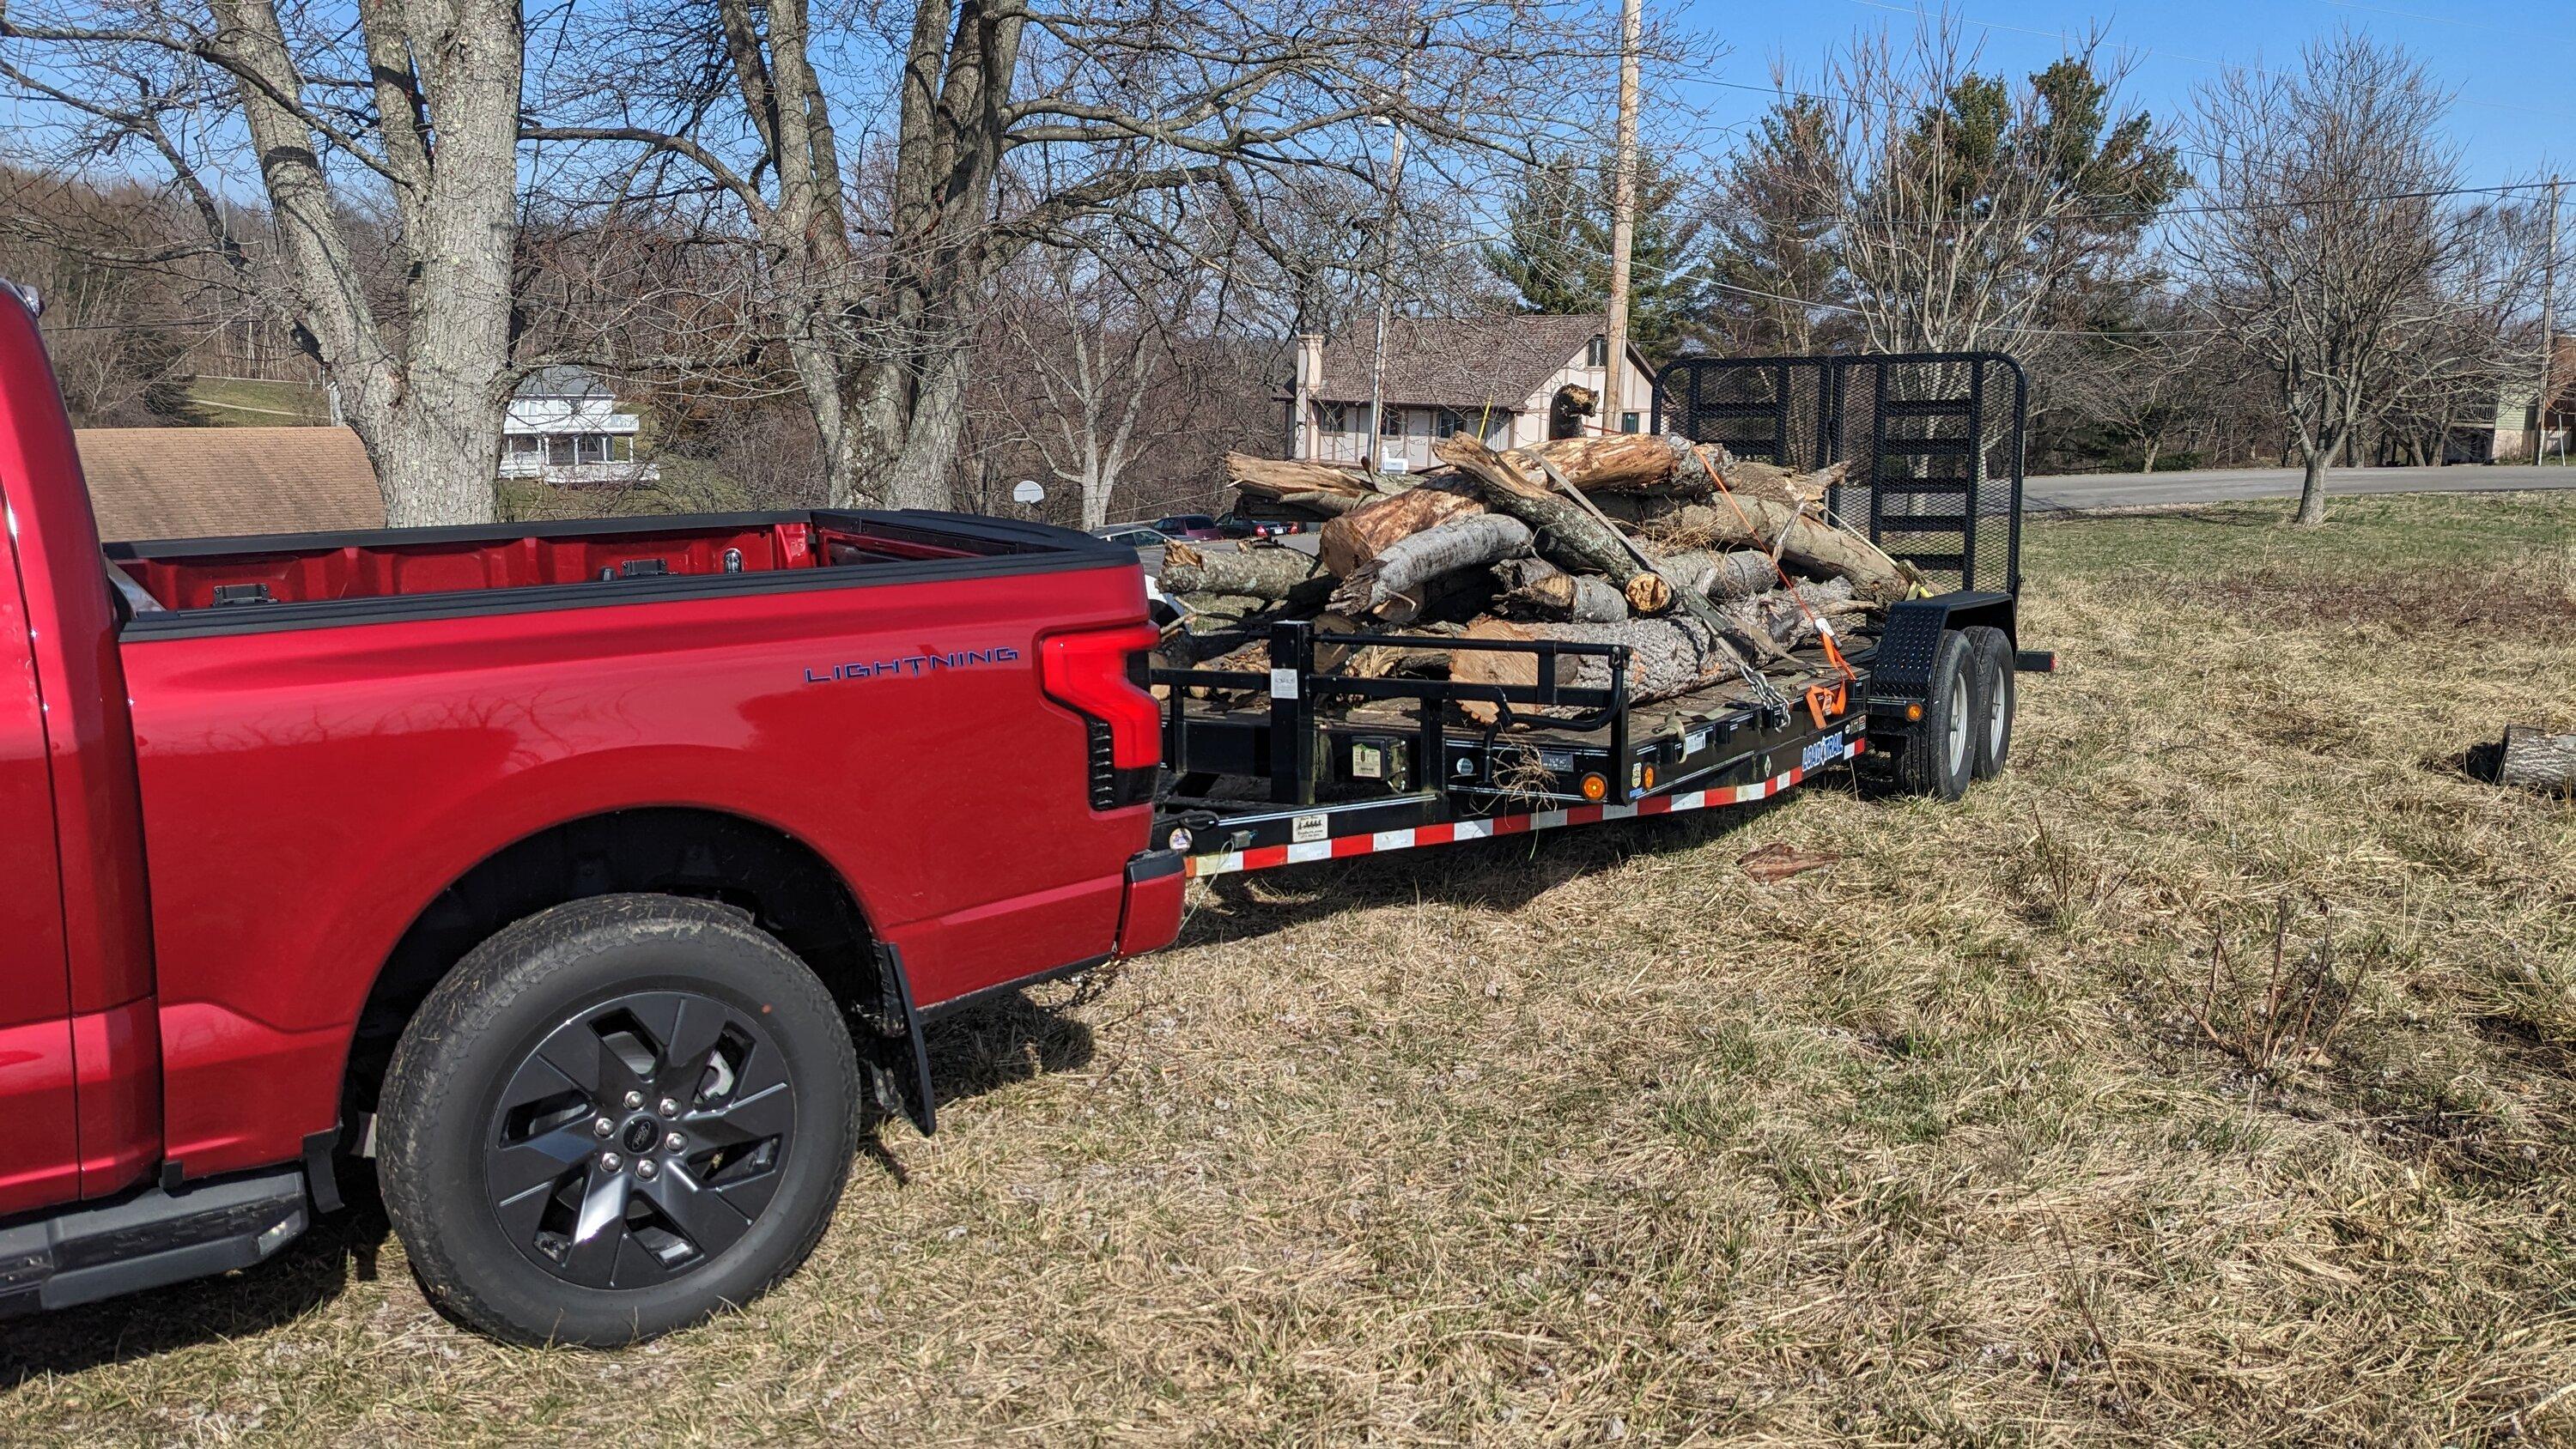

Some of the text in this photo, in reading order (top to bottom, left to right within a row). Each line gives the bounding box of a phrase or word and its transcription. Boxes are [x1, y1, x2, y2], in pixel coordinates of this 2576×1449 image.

[805, 646, 1020, 682] LIGHTNING
[1802, 731, 1844, 773] LOAD TRAIL
